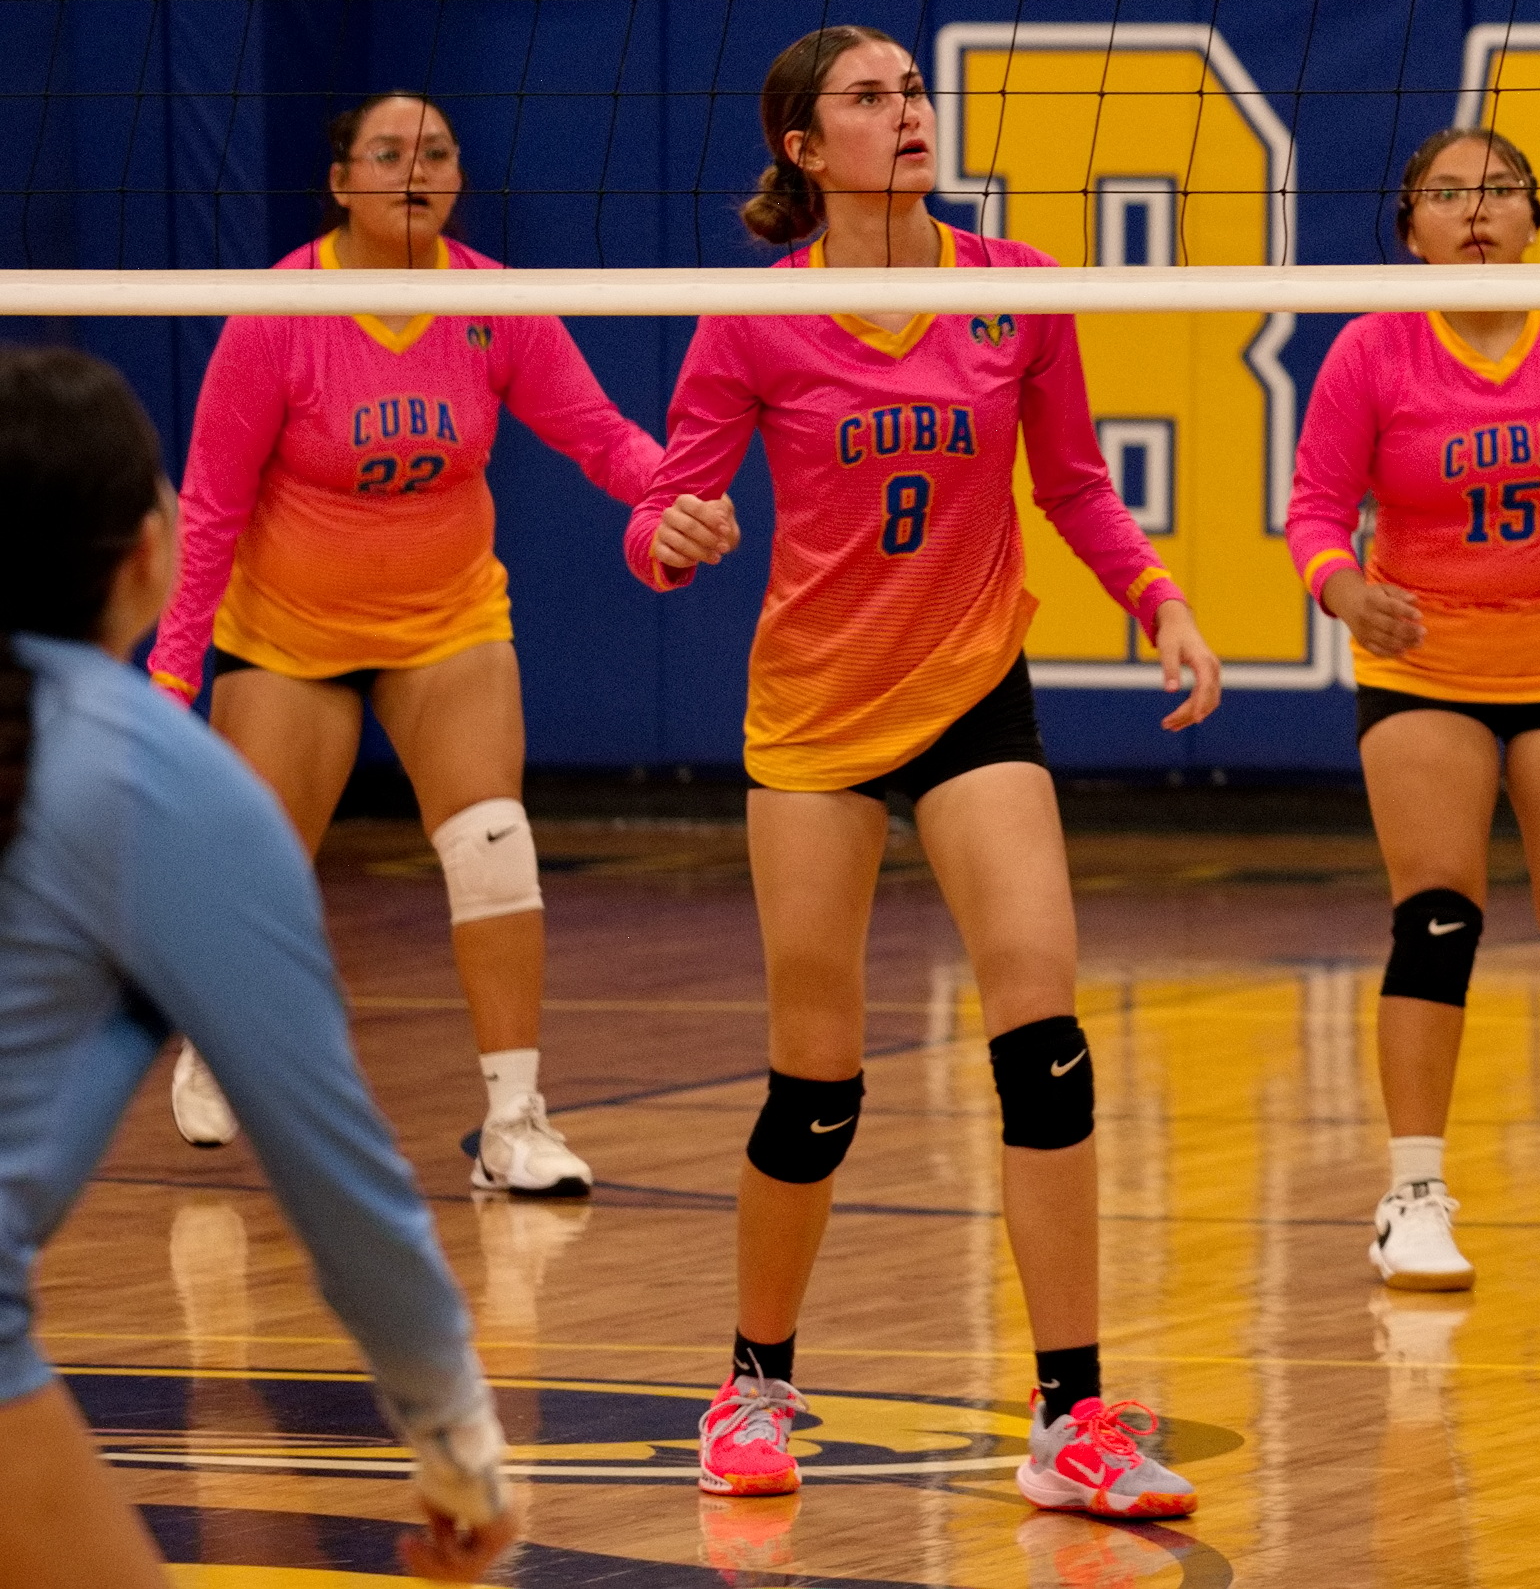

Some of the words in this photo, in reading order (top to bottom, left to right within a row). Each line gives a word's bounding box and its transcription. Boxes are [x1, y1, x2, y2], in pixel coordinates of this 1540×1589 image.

[350, 396, 461, 449] CUBA
[837, 402, 978, 467] CUBA
[356, 454, 447, 495] 22
[879, 470, 934, 558] 8
